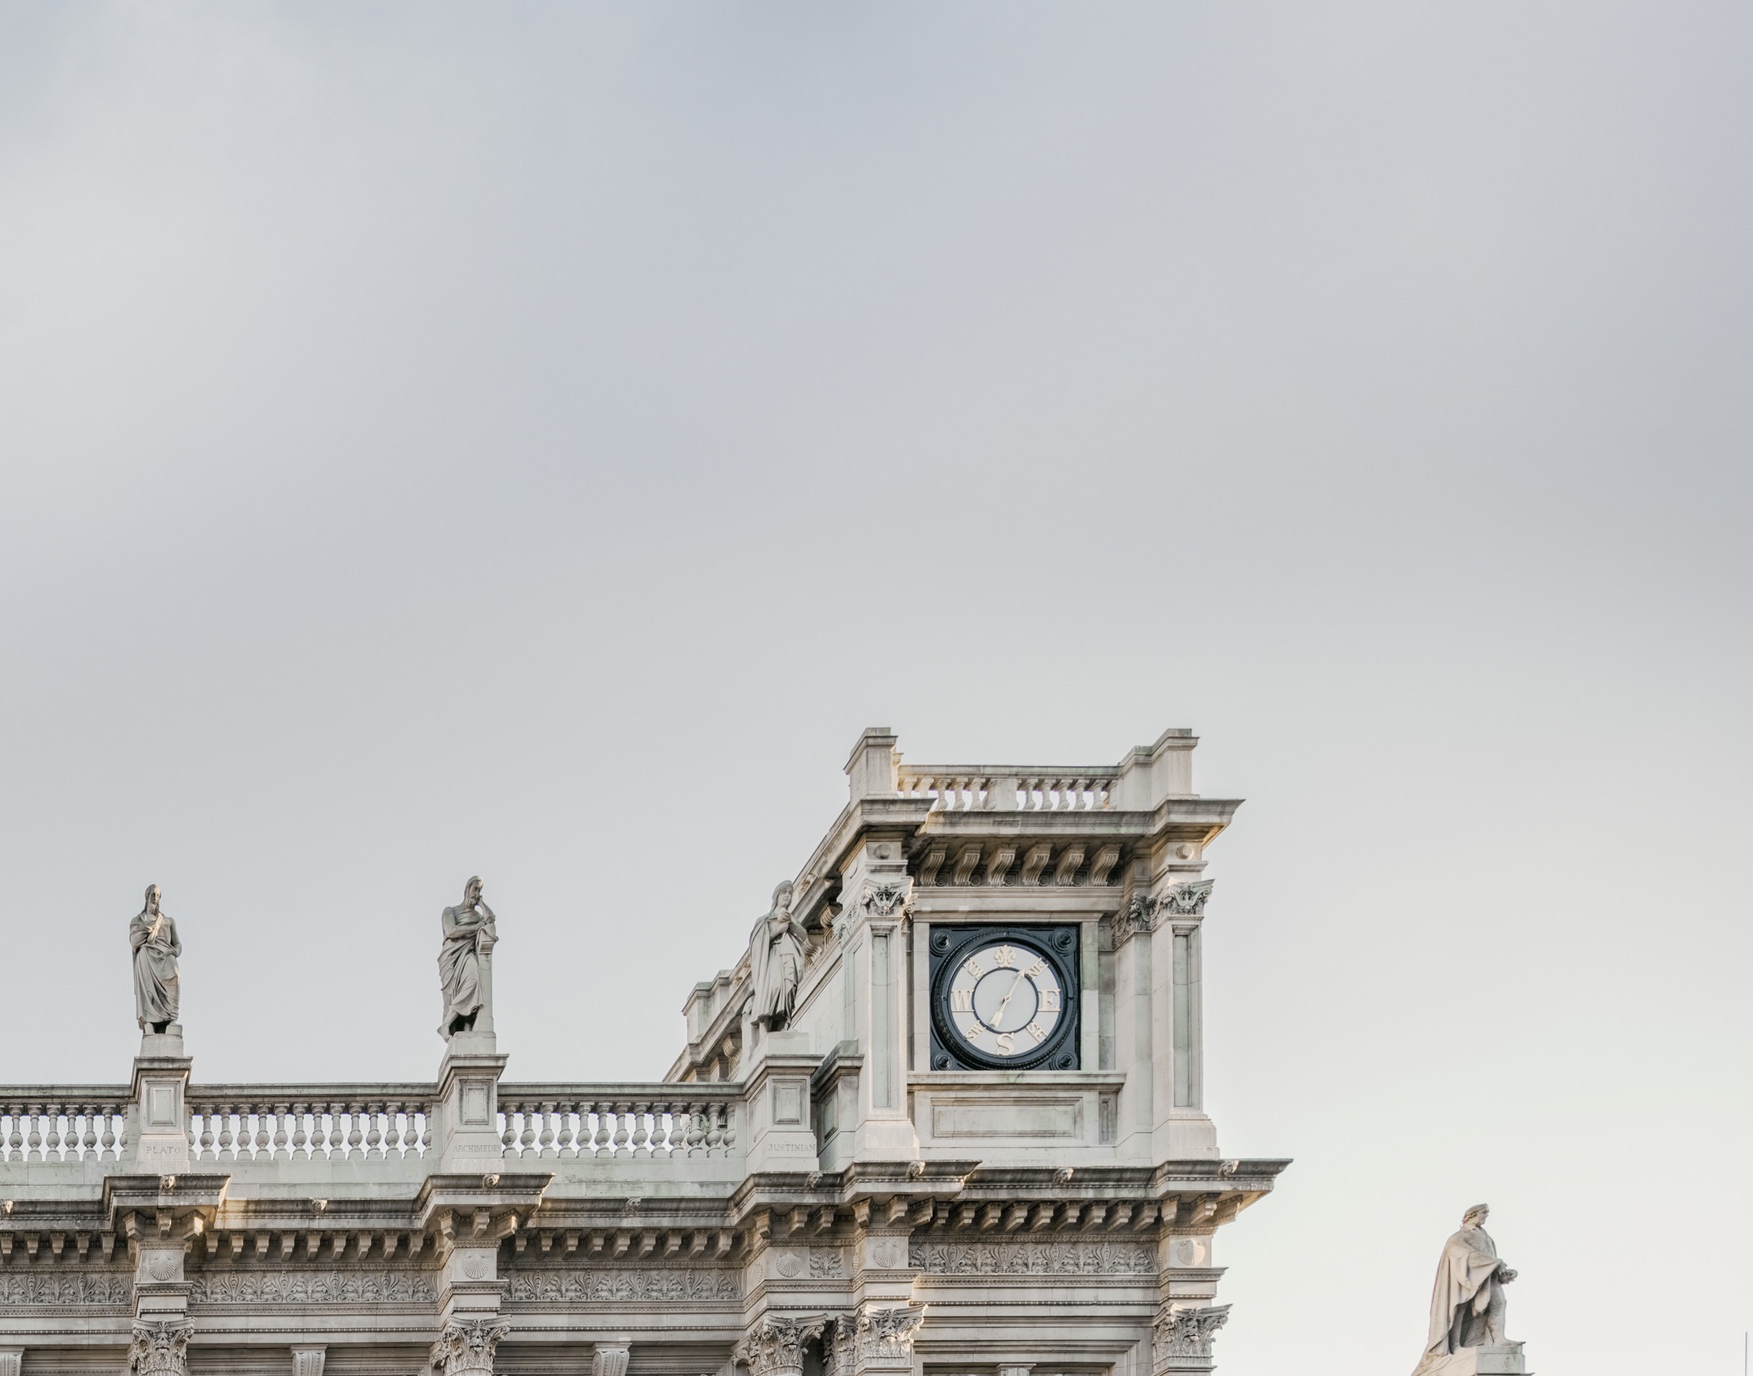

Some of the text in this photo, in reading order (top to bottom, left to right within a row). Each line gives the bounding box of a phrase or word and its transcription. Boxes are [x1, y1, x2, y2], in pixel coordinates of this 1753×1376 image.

[963, 958, 985, 981] NW
[1028, 957, 1049, 980] NE
[951, 989, 974, 1012] W
[1038, 988, 1061, 1012] E
[964, 1020, 987, 1042] SW
[1026, 1021, 1048, 1043] SE
[996, 1032, 1015, 1056] S
[146, 1146, 181, 1154] PLATO
[453, 1144, 502, 1153] ARCHIMEDES
[768, 1144, 816, 1152] JUSTINIAN
